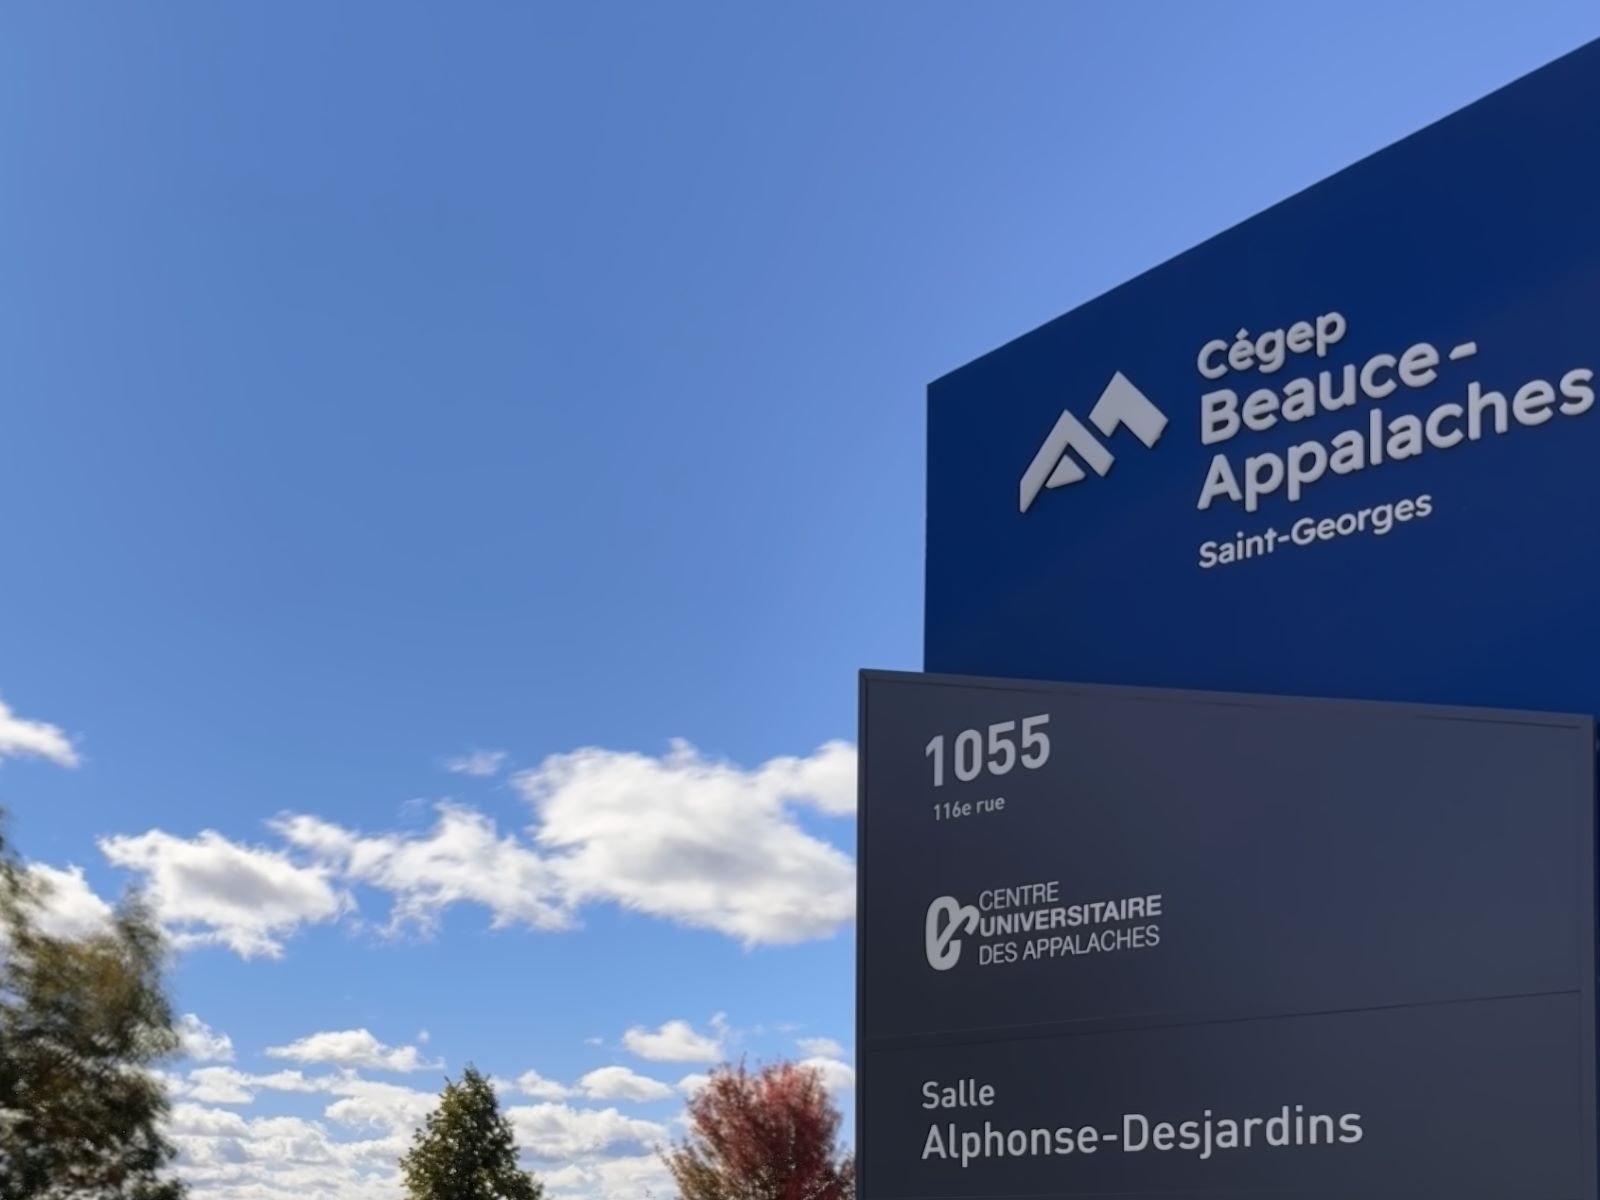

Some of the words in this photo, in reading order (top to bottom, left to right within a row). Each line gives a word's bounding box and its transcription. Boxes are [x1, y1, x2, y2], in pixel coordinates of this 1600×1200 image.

[1197, 311, 1346, 379] Cégep
[1201, 341, 1477, 445] Beauce-
[1197, 368, 1596, 512] Appalaches
[1199, 494, 1433, 568] Saint-Georges
[924, 713, 1051, 788] 1055
[933, 801, 972, 820] 116e
[976, 797, 1005, 813] rue
[979, 881, 1059, 911] CENTRE
[980, 894, 1162, 937] UNIVERSITAIRE
[979, 942, 1018, 965] DES
[1022, 924, 1160, 960] APPALACHES
[922, 1078, 995, 1109] Salle
[921, 1105, 1363, 1168] Alphonse-Desjardins
